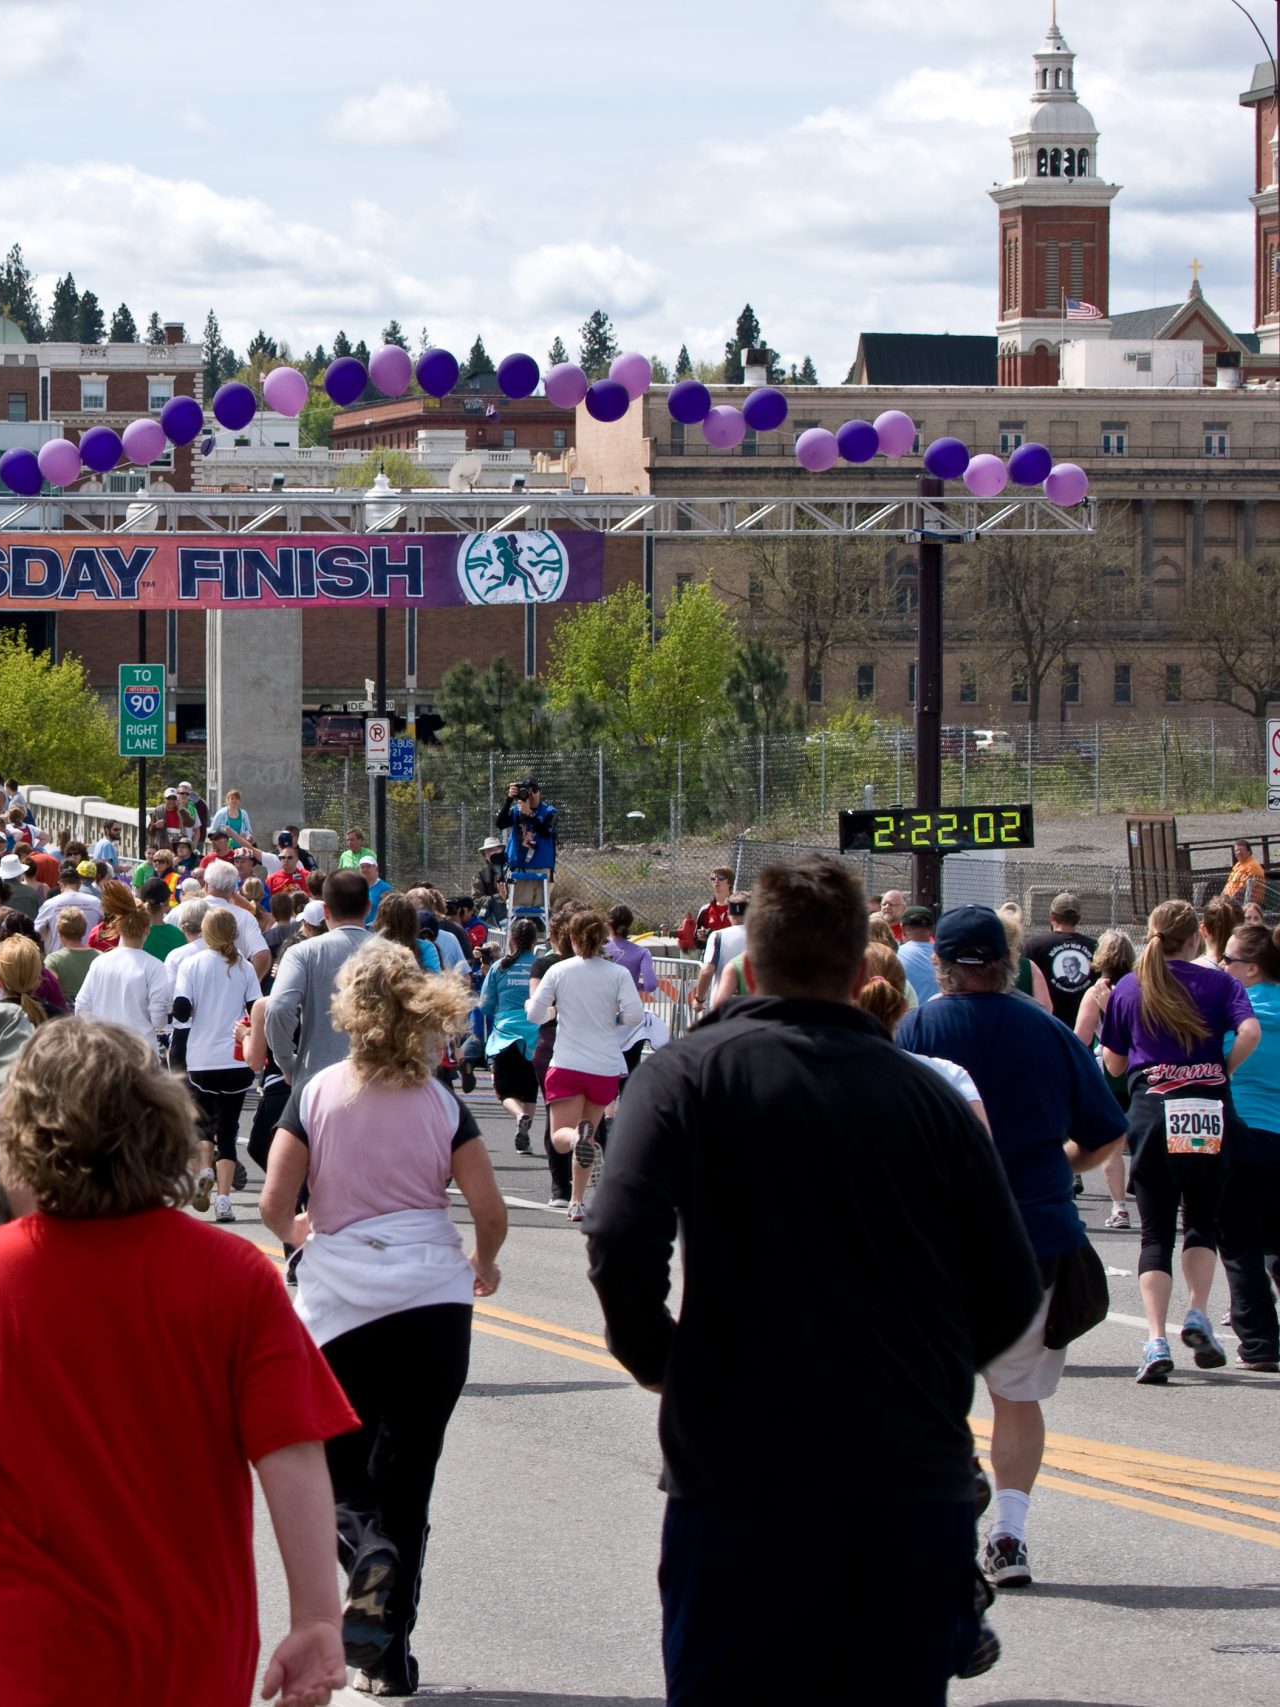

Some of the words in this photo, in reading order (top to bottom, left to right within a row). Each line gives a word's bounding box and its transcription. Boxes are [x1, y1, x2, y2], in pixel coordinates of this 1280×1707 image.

[1137, 483, 1238, 491] MASONIC
[177, 546, 424, 600] FINISH
[133, 669, 152, 682] TO
[130, 694, 155, 713] 90
[126, 724, 158, 736] RIGHT
[126, 739, 158, 750] LANE
[397, 740, 414, 748] BUS
[392, 748, 401, 757] 21
[403, 754, 414, 763] 22
[392, 761, 402, 770] 23
[403, 766, 413, 775] 24
[1169, 1113, 1221, 1136] 32046
